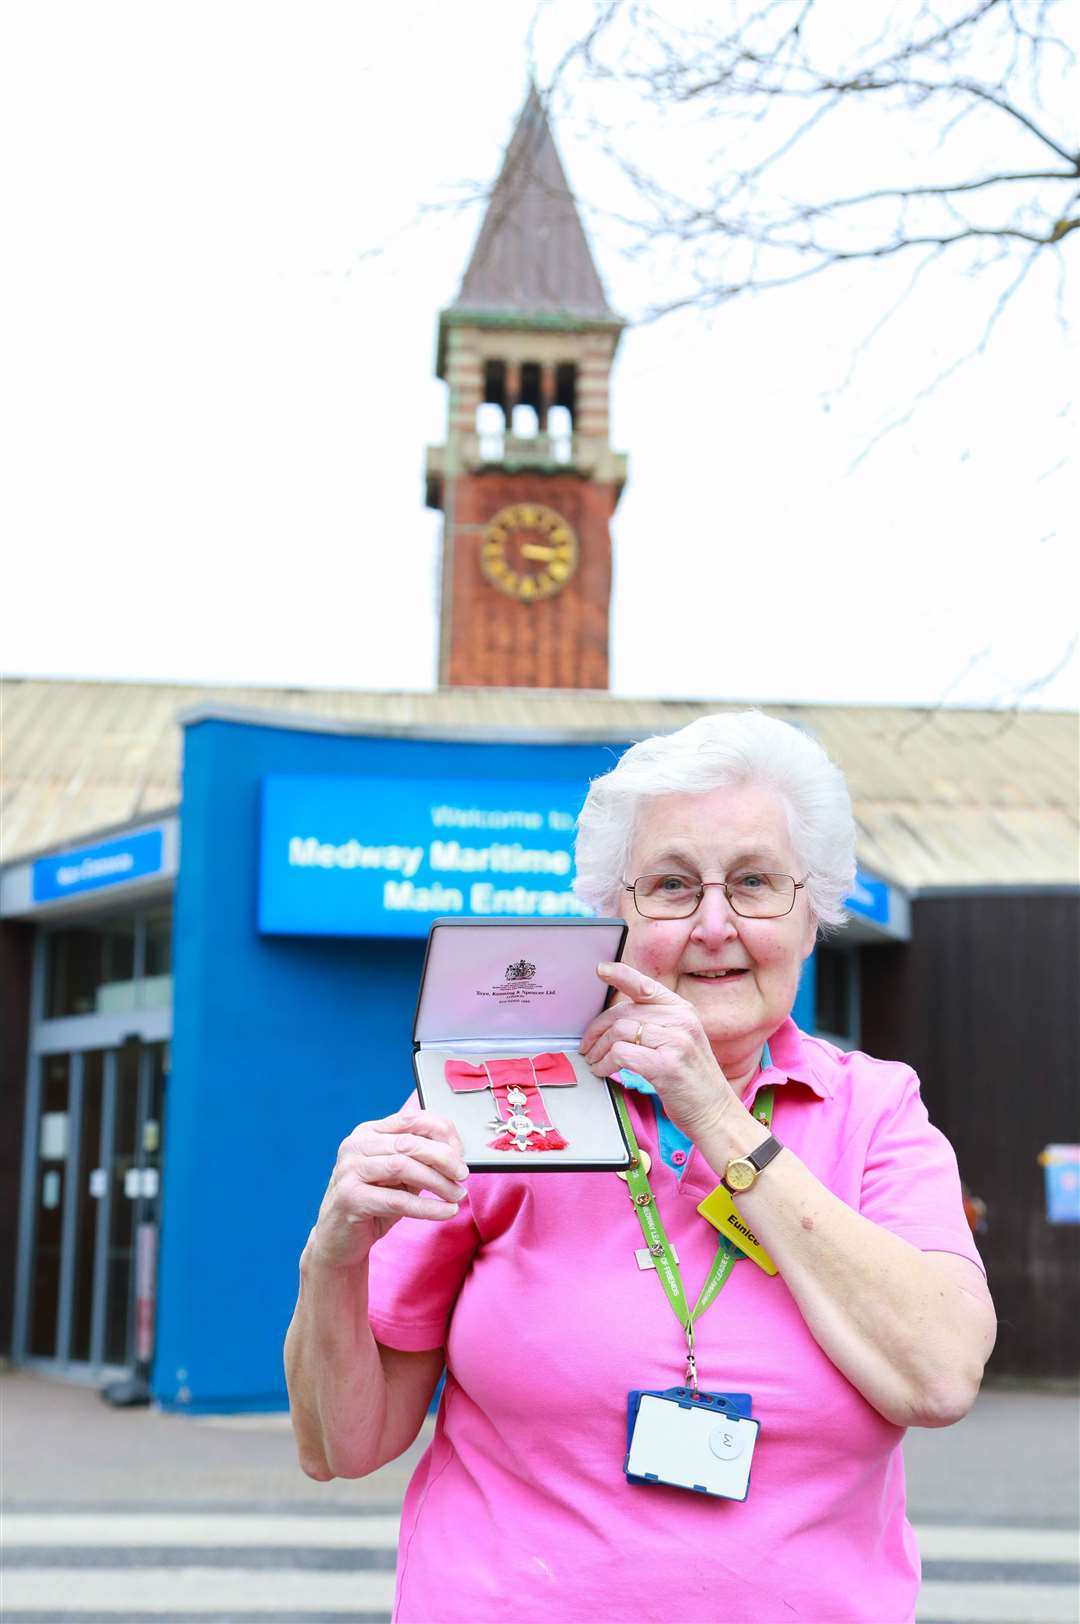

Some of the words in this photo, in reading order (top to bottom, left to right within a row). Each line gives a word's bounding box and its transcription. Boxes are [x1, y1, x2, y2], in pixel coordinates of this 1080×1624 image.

[431, 806, 542, 829] Welcome
[548, 811, 574, 830] to
[289, 837, 424, 877] Medway
[430, 841, 571, 875] Maritime
[384, 880, 462, 912] Main
[470, 883, 592, 916] Entran
[727, 1214, 760, 1247] Eunice
